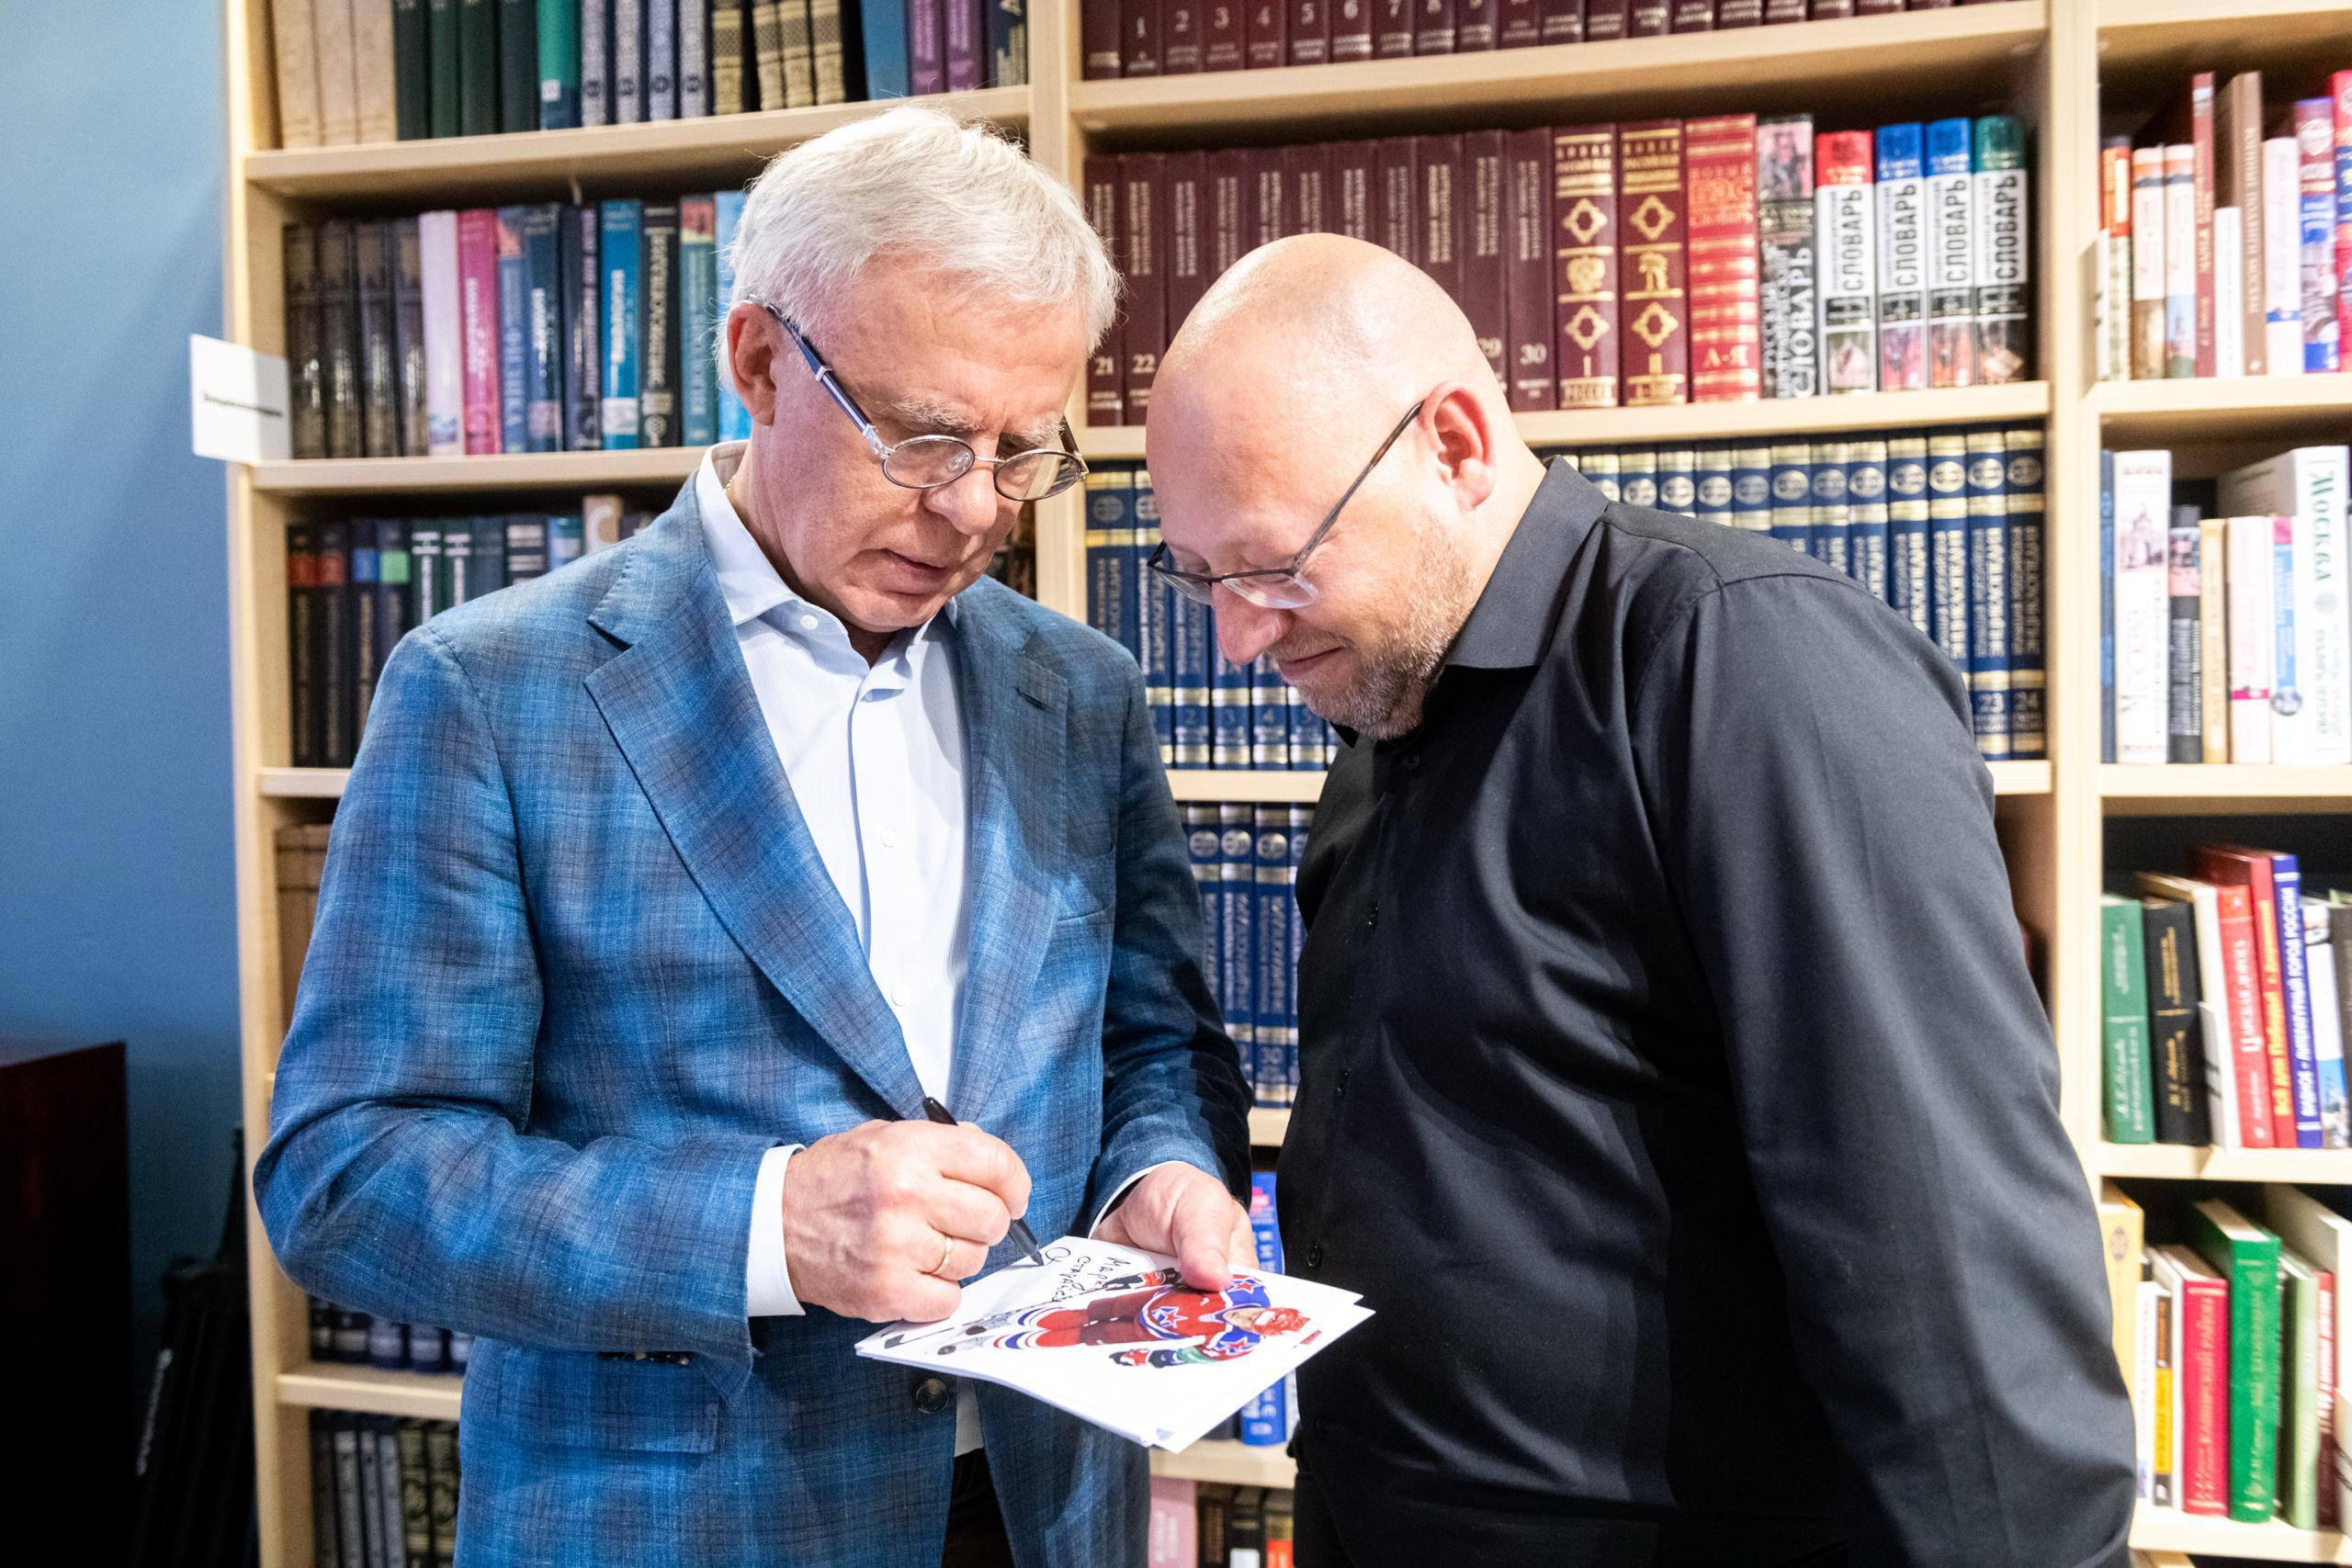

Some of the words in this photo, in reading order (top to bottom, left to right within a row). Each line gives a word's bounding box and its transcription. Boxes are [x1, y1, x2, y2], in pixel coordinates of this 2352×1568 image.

[1175, 9, 1191, 32] 2
[1214, 6, 1230, 29] 3
[1256, 6, 1271, 27] 4
[1301, 2, 1315, 25] 5
[1343, 0, 1359, 20] 6
[1136, 16, 1147, 39] 1
[1894, 185, 1917, 287] СЛОВАРЬ
[1946, 180, 1967, 282] СЛОВАРЬ
[1995, 175, 2018, 279] СЛОВАРЬ
[1841, 189, 1864, 291] СЛОВАРЬ
[1789, 248, 1815, 397] СЛОВАРЬ
[1095, 355, 1114, 376] 21
[1131, 354, 1157, 374] 22
[1520, 344, 1547, 365] 30
[1704, 344, 1748, 367] А-Я
[1978, 692, 2004, 713] 23
[1263, 707, 1274, 723] 4
[2280, 886, 2299, 937] РОССИИ
[2284, 939, 2302, 976] ГОРОД
